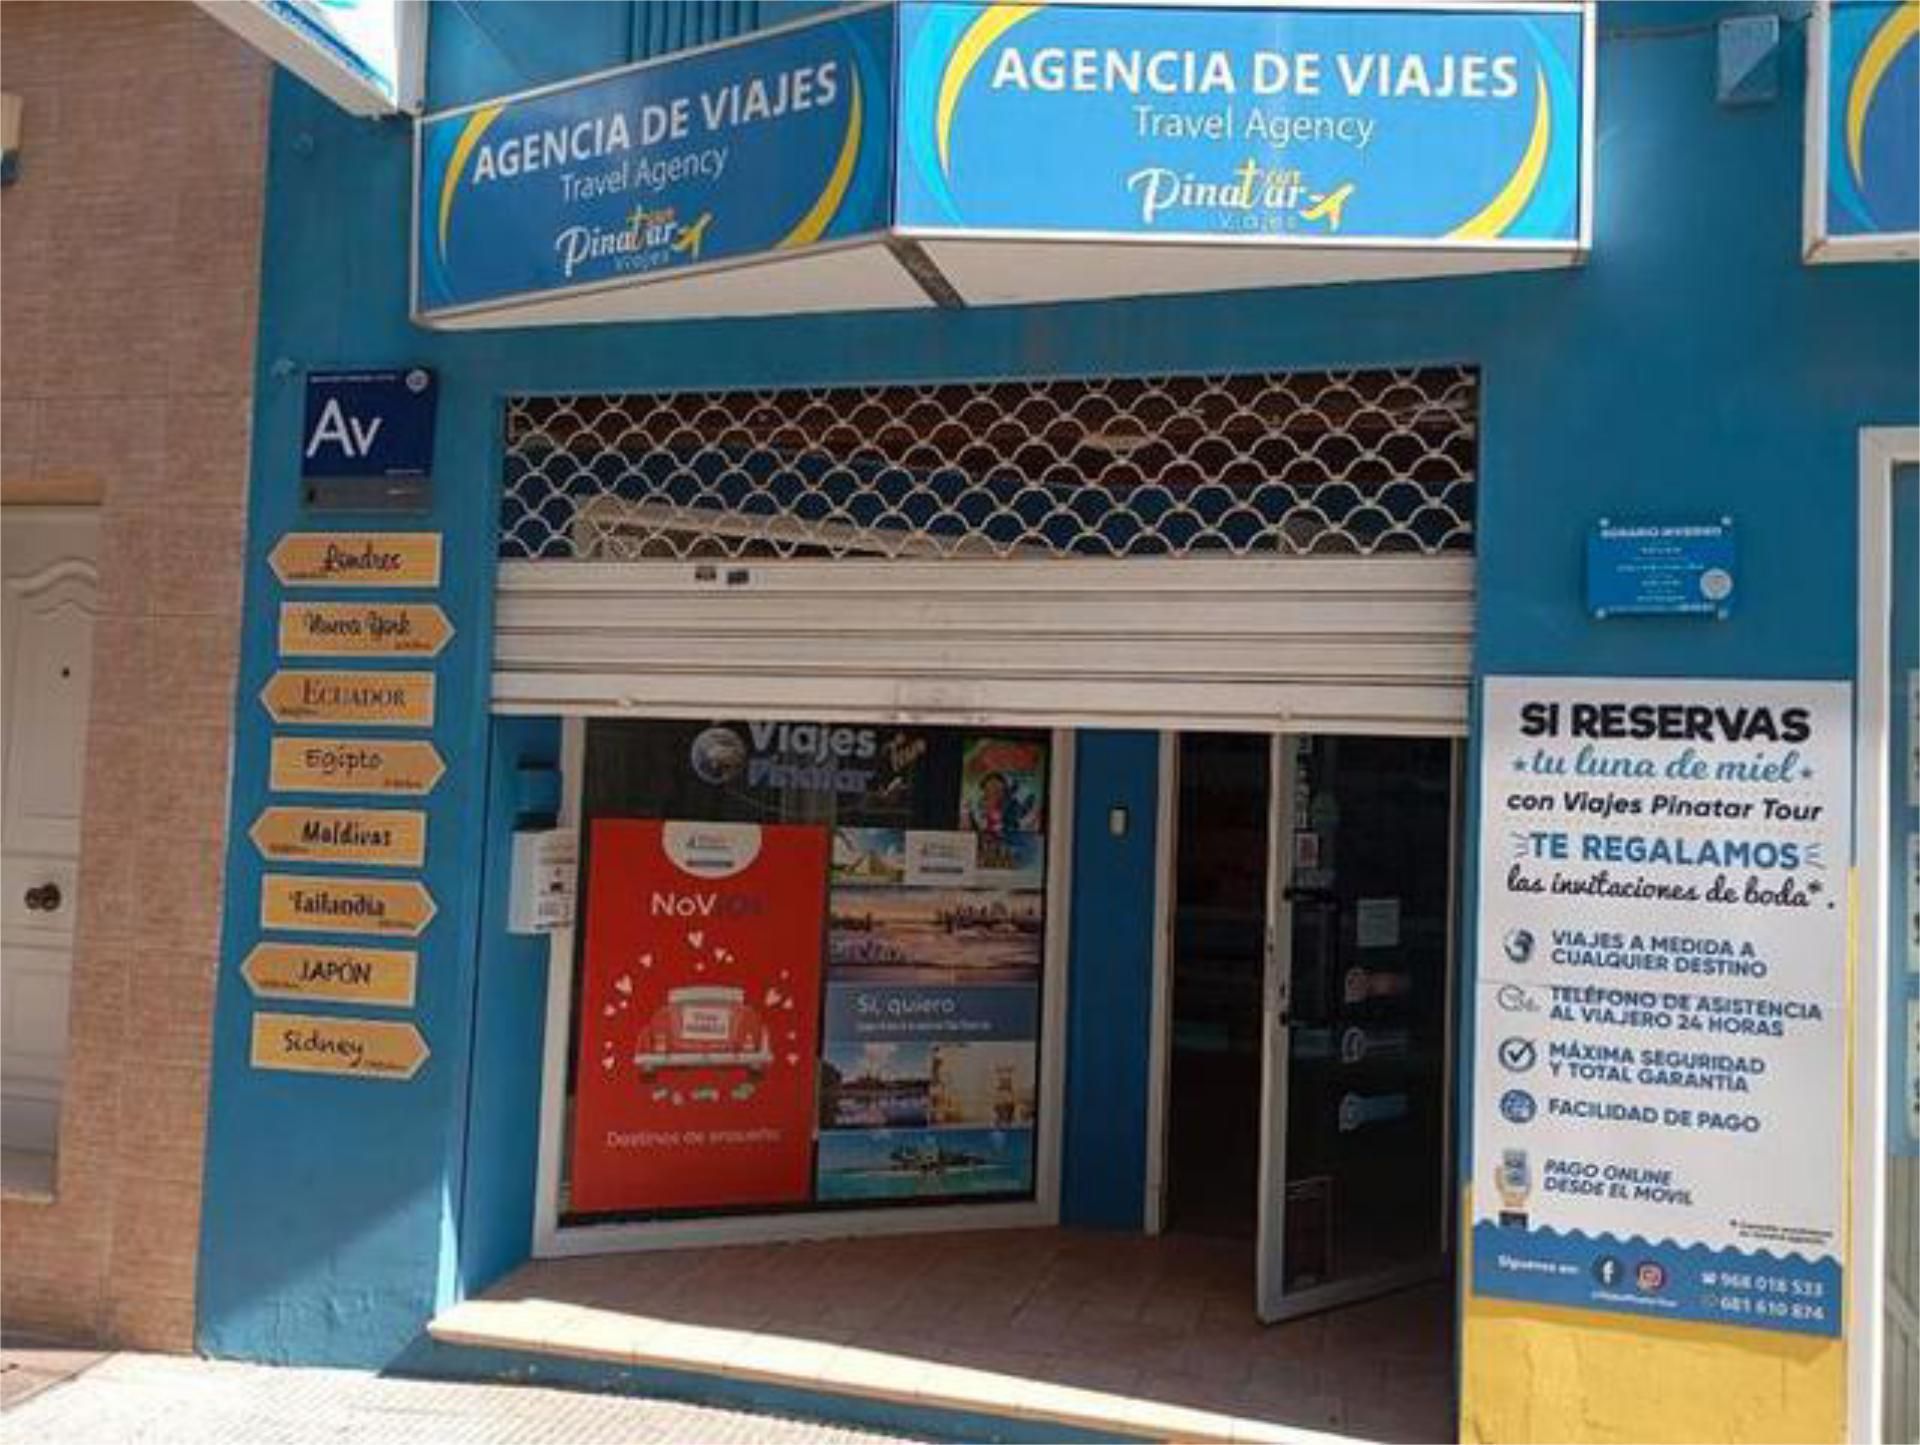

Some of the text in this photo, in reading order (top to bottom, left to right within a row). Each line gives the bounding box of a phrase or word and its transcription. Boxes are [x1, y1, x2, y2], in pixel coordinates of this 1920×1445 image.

[991, 46, 1519, 99] AGENCIA DE VIAJES
[473, 61, 838, 185] AGENCIA DE VIAJES
[1134, 105, 1375, 145] Travel Agency
[559, 145, 729, 201] Travel Agency
[1127, 157, 1308, 224] Pinatar
[555, 204, 678, 278] Pinatar
[306, 397, 383, 458] Av
[321, 542, 402, 571] Londres
[304, 609, 410, 642] Nueva York
[302, 680, 406, 706] ECUADOR
[1520, 702, 1811, 743] SI RESERVAS
[749, 720, 877, 763] Viajes
[305, 746, 383, 775] Egipto
[1532, 744, 1801, 784] tu luna de miel
[1507, 791, 1824, 822] con Viajes Pinatar Tour
[1529, 832, 1801, 870] TE REGALAMOS
[1507, 864, 1546, 893] las
[1552, 869, 1698, 901] invitaciones
[1705, 873, 1739, 905] de
[288, 891, 386, 916] Tailandia
[1550, 929, 1756, 957] VIAJES A MEDIDA A
[1551, 949, 1767, 979] CUALQUIER DESTINO
[1550, 985, 1823, 1021] TELÉFONO DE ASISTENCIA
[1550, 1005, 1784, 1038] AL VIAJERO 24 HORAS
[284, 1029, 364, 1067] Sidney
[1550, 1039, 1765, 1075] MÁXIMA SEGURIDAD
[1549, 1062, 1564, 1078] Y
[1569, 1063, 1632, 1084] TOTAL
[1548, 1098, 1761, 1133] FACILIDAD DE PAGO
[1543, 1158, 1674, 1186] PAGO ONLINE
[1543, 1176, 1605, 1197] DESDE
[1609, 1182, 1629, 1200] EL
